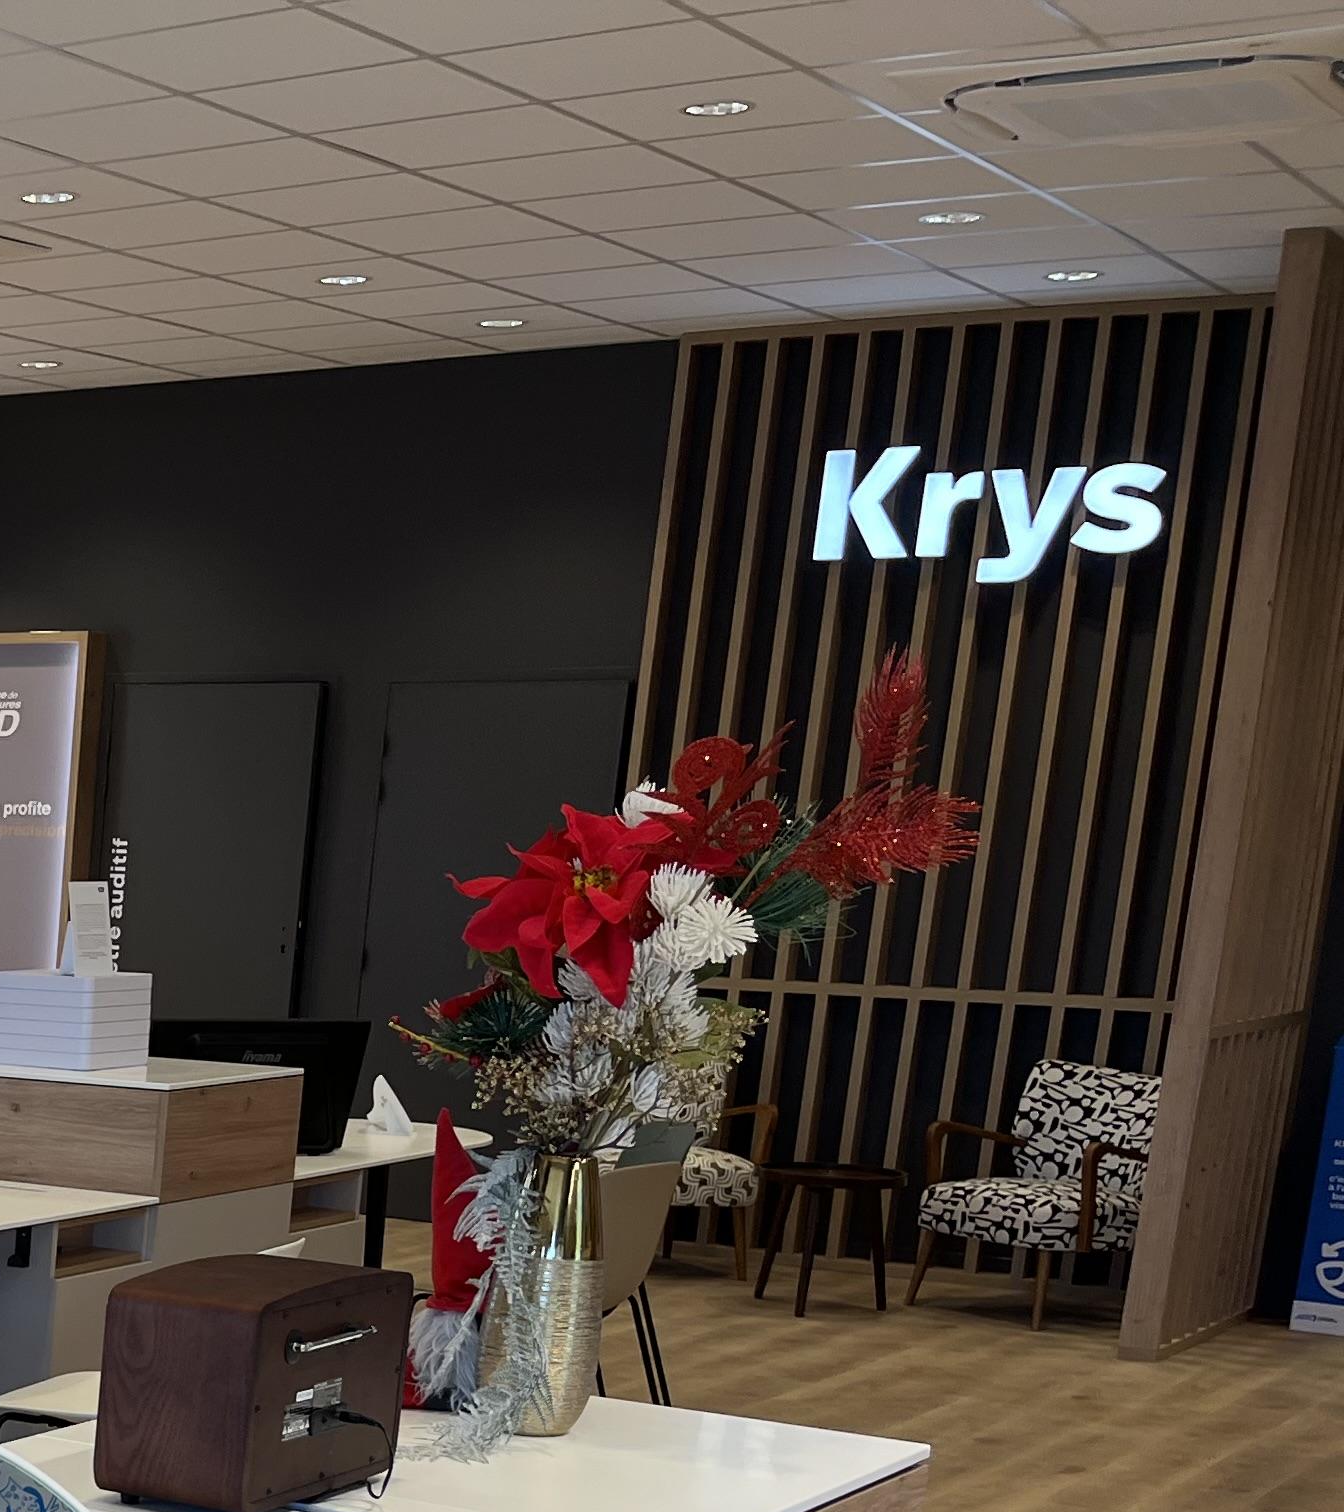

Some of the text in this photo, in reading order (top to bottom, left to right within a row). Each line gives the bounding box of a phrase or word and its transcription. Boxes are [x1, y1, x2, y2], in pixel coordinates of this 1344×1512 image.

[812, 445, 1167, 583] Krys
[7, 691, 19, 700] de
[3, 800, 52, 818] profite
[110, 838, 128, 919] auditif
